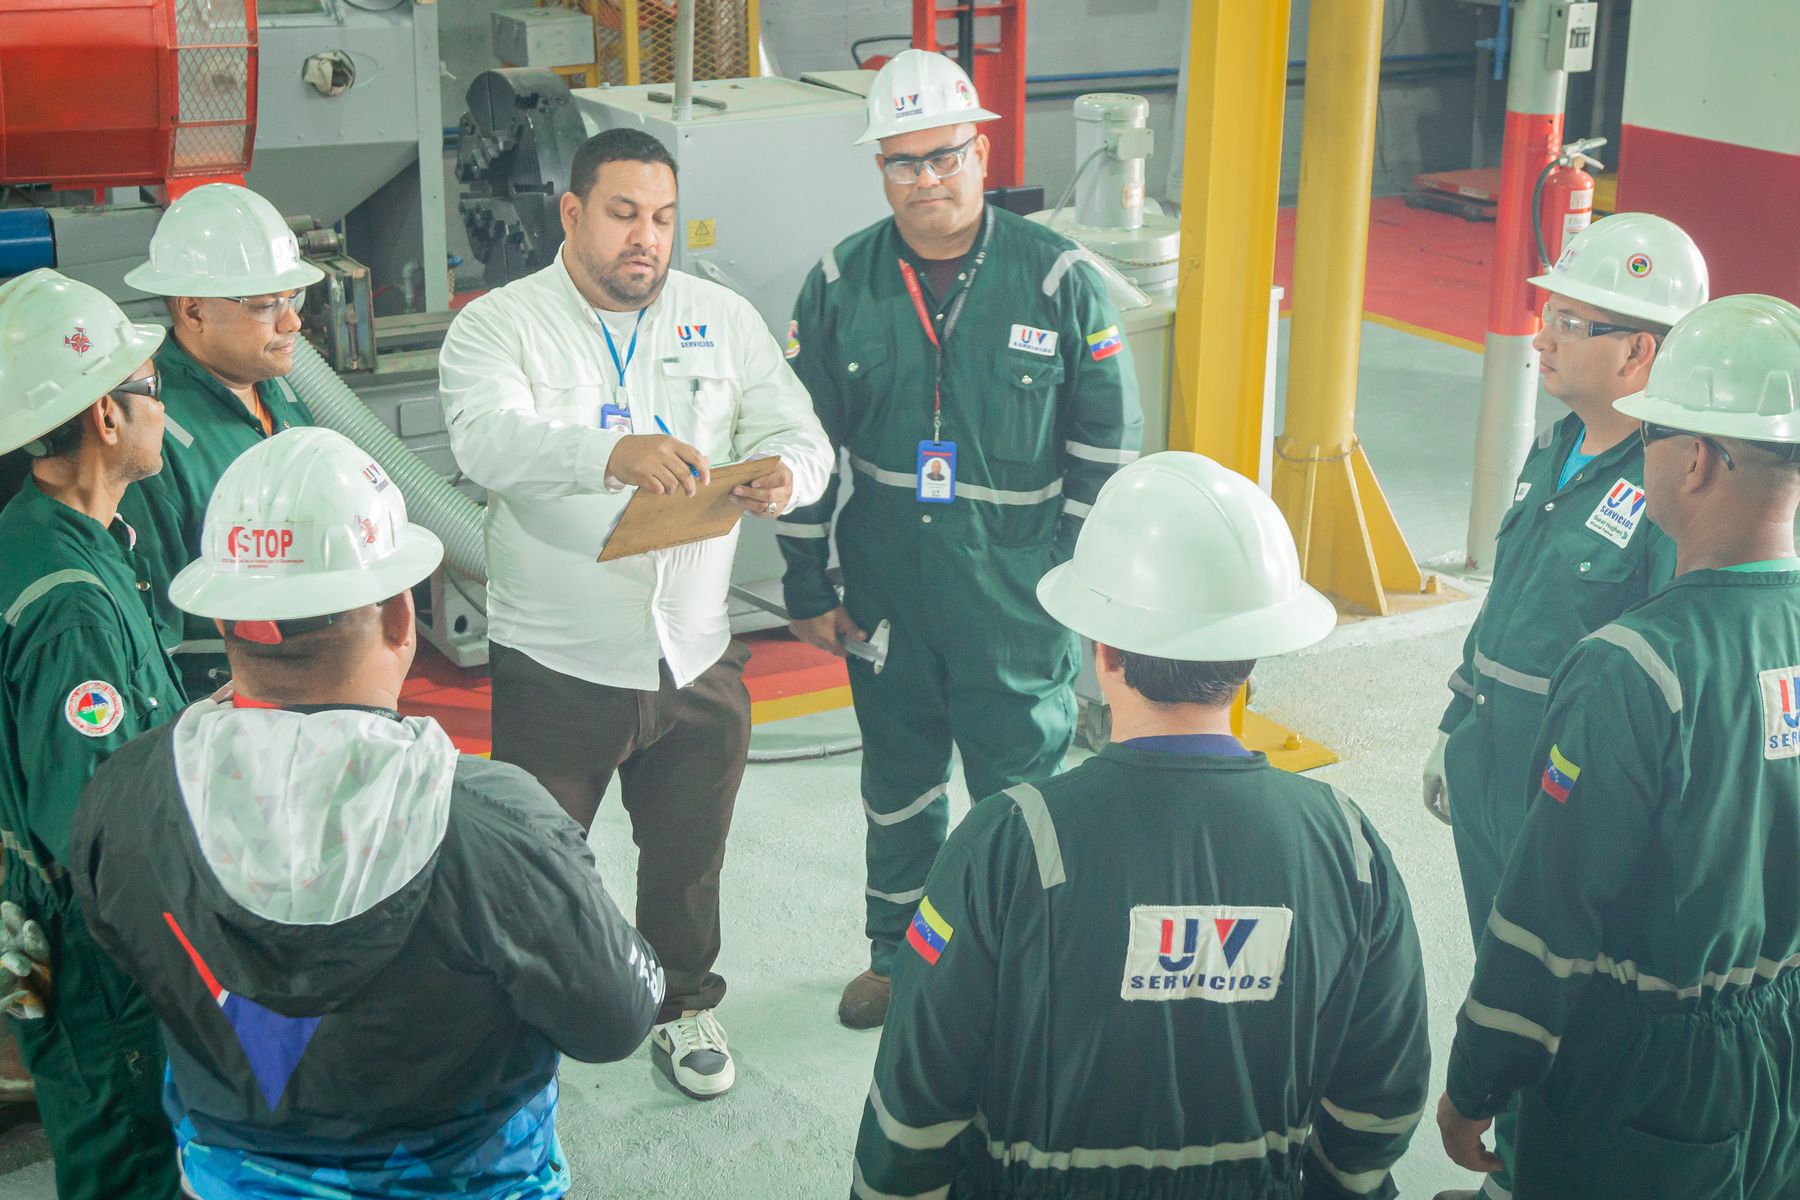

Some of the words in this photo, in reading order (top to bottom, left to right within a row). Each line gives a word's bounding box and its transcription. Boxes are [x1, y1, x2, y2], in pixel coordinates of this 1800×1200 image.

[893, 94, 919, 111] UV
[677, 324, 707, 340] UV
[1021, 328, 1048, 345] UV
[1607, 482, 1646, 517] UV
[1600, 505, 1634, 530] SERVICIOS
[227, 526, 293, 558] STOP
[1158, 918, 1260, 972] UV
[1130, 973, 1273, 991] SERVICIOS
